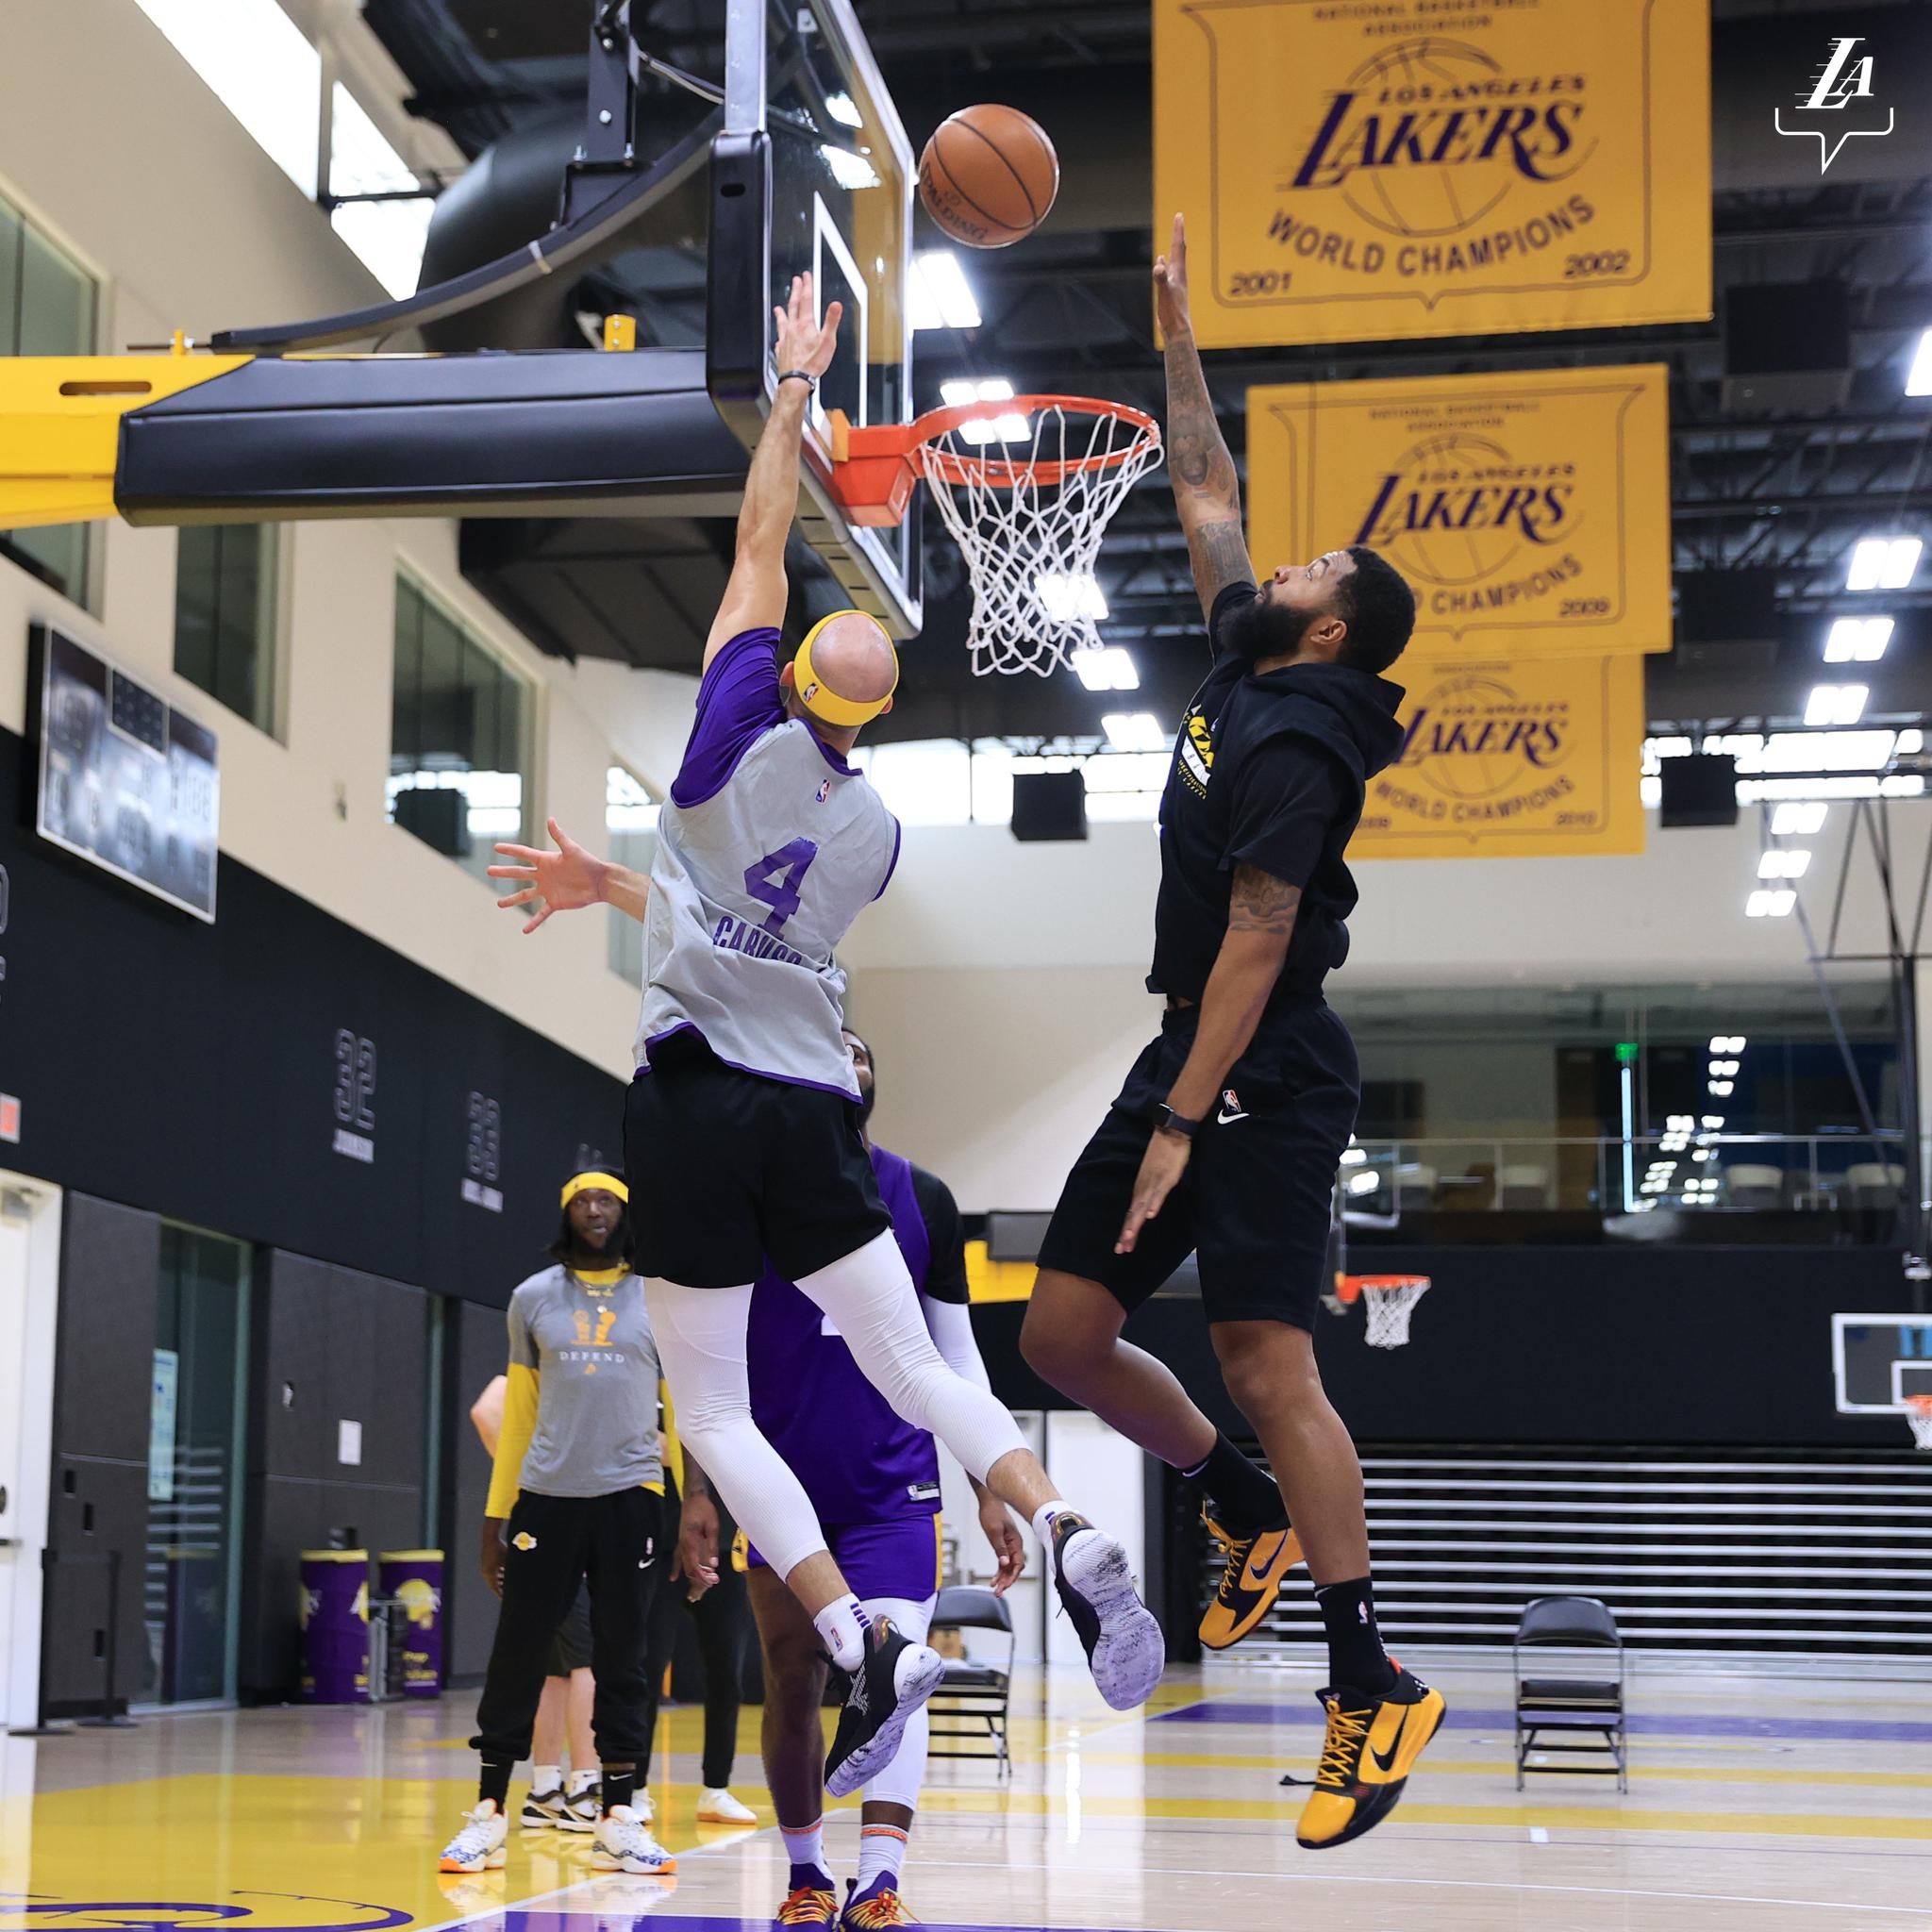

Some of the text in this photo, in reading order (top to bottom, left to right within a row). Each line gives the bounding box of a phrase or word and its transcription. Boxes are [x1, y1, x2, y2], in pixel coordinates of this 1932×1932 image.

[1376, 83, 1433, 106] LOS
[1275, 90, 1599, 190] LAKERS
[1267, 193, 1596, 276] WORLD CHAMPIONS
[1562, 248, 1631, 279] 2002
[1229, 270, 1292, 296] 2001
[1355, 474, 1586, 547] LAKERS
[1431, 553, 1584, 616] CHAMPIONS
[1391, 708, 1579, 770] LAKERS
[743, 837, 819, 941] 4
[559, 1350, 625, 1363] DEFEND
